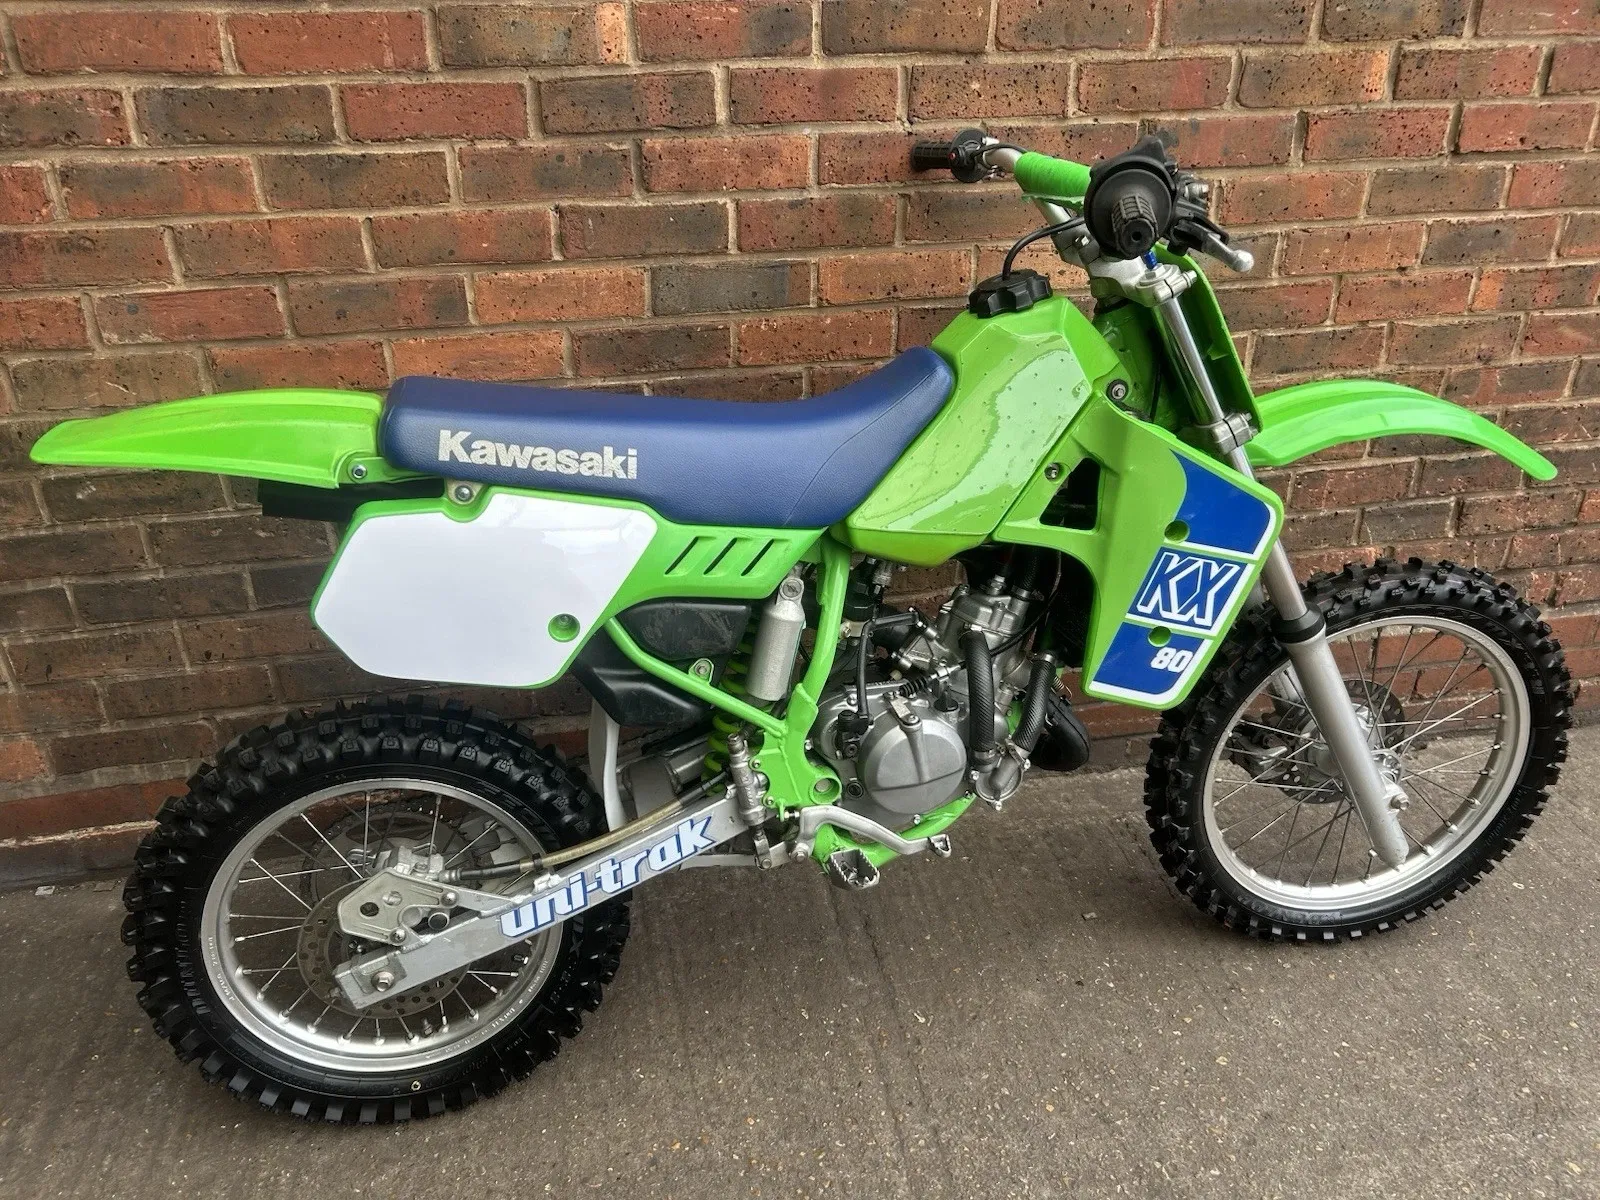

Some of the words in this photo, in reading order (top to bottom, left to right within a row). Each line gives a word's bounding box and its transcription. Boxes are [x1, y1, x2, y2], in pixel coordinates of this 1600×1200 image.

[438, 429, 638, 480] Kawasaki
[1136, 551, 1241, 627] KX
[1150, 647, 1194, 673] 80
[500, 815, 717, 938] uni-trak
